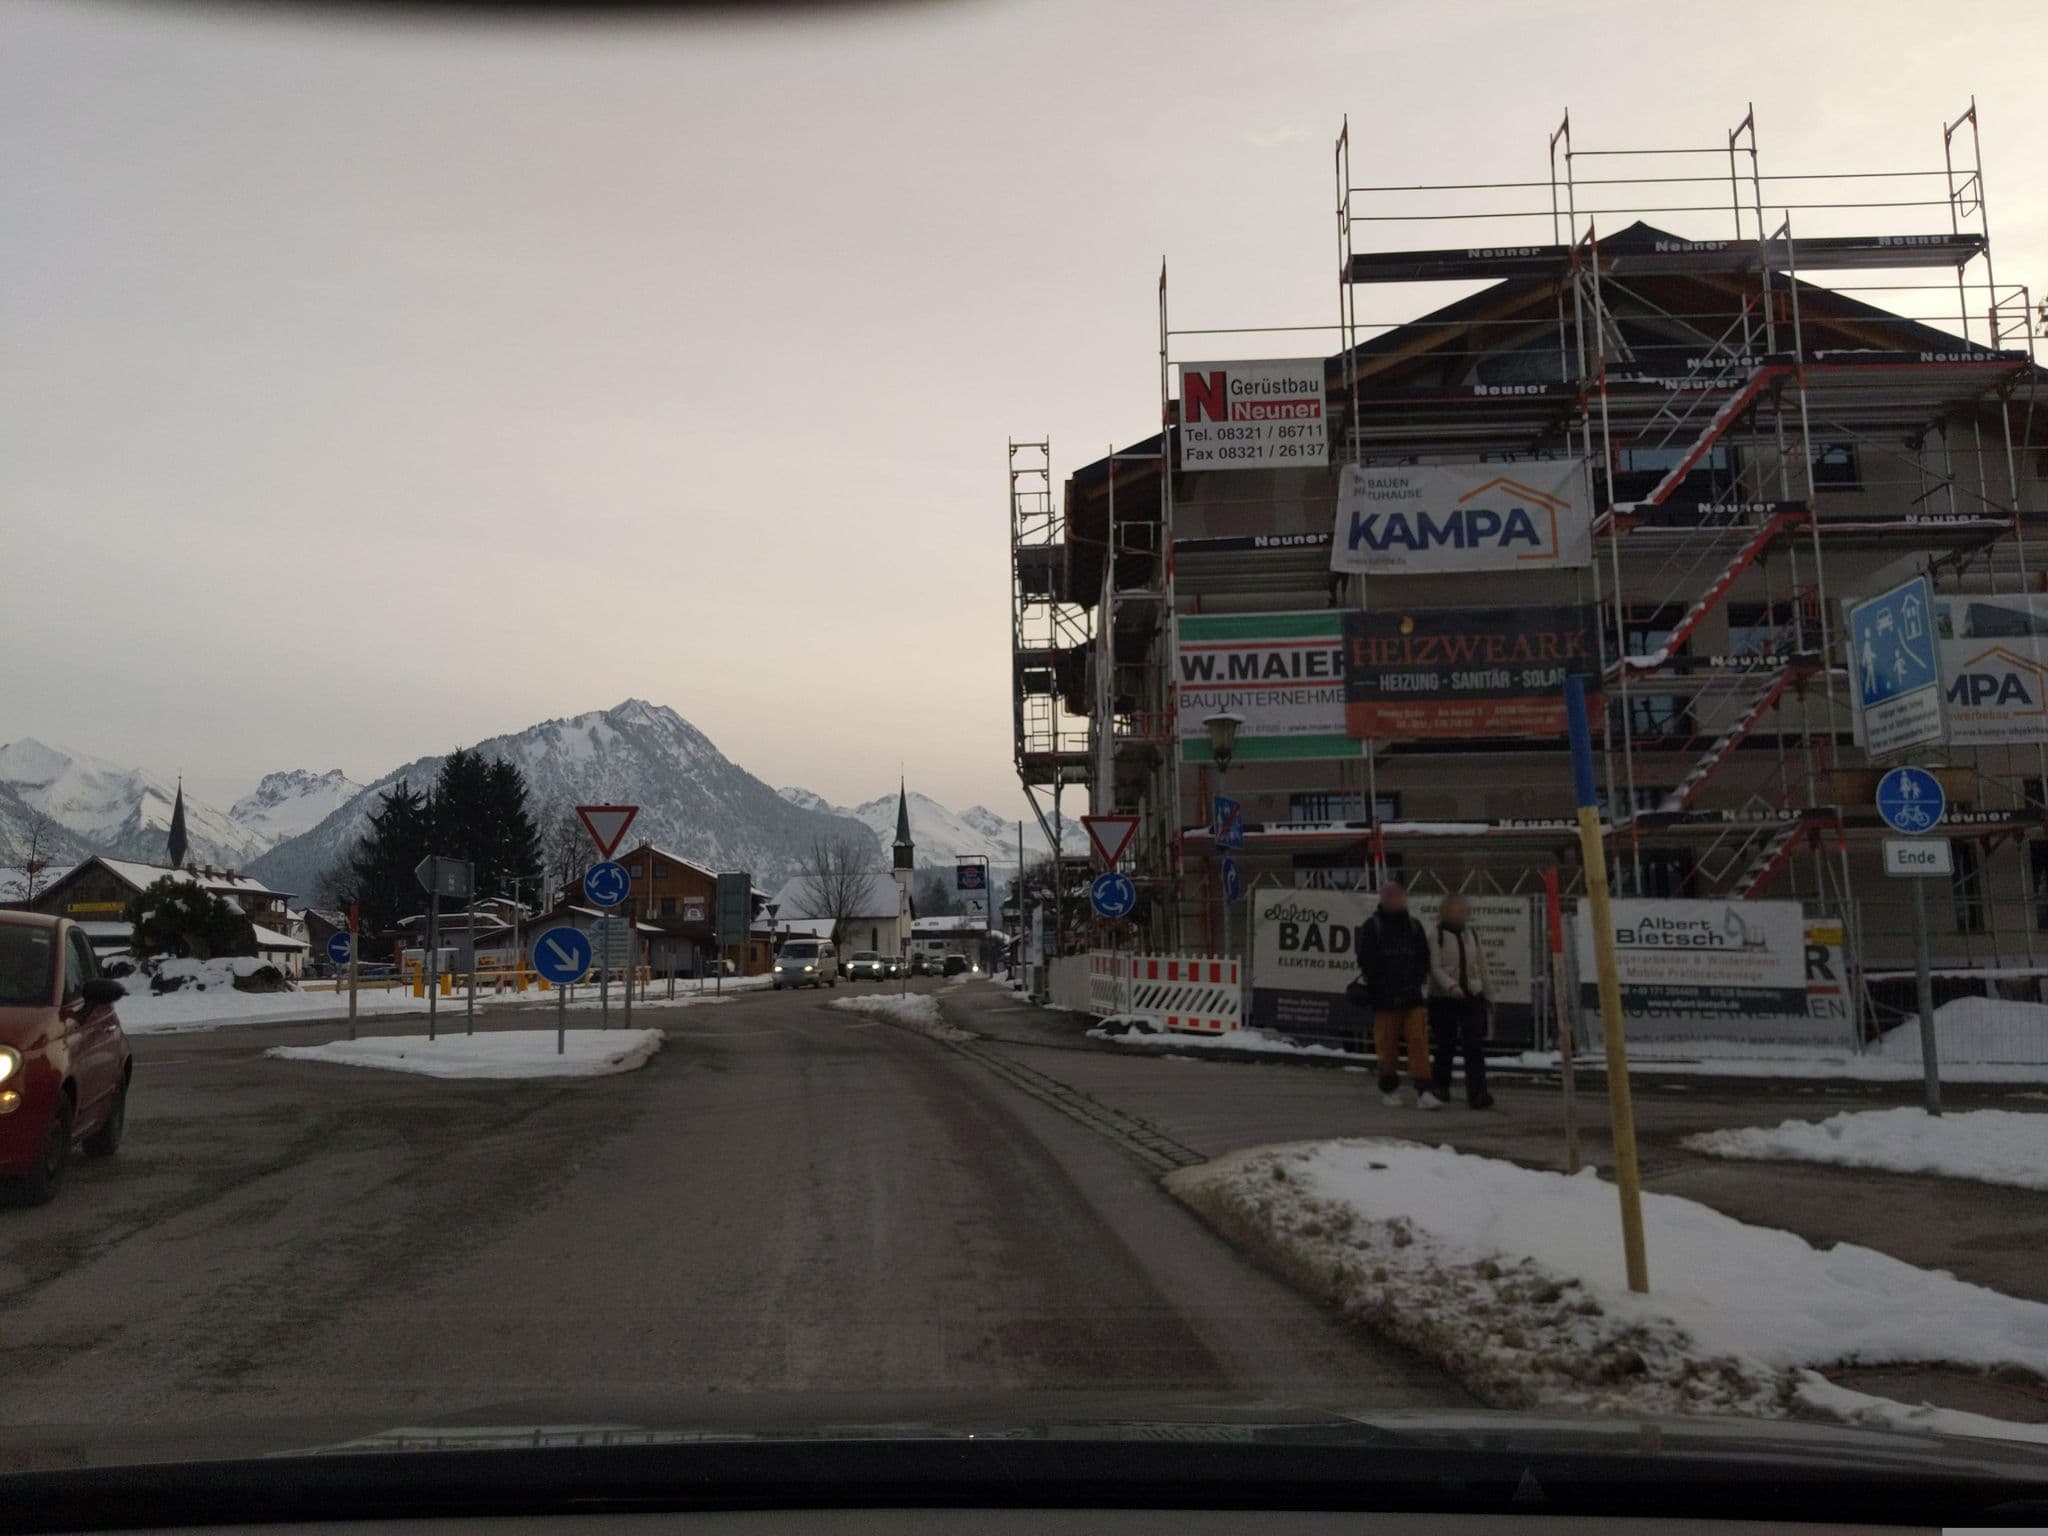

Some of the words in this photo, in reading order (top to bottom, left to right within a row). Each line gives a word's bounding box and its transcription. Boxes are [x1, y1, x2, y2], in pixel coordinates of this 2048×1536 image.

[1467, 247, 1542, 258] Neuner
[1920, 351, 1996, 362] Neuner
[1231, 378, 1319, 395] Gerüstbau
[1473, 384, 1549, 396] Neuner
[1184, 371, 1229, 423] N
[1234, 401, 1319, 420] Neuner
[1185, 430, 1213, 441] Tel.
[1217, 427, 1261, 441] 08321
[1278, 424, 1323, 438] 86711
[1186, 448, 1214, 461] Fax
[1219, 446, 1263, 459] 08321
[1279, 443, 1325, 457] 26137
[1349, 507, 1541, 550] KAMPA
[1254, 533, 1329, 547] Neuner
[1379, 673, 1439, 691] HEIZUNG
[1451, 668, 1511, 689] SANITÄR
[1946, 672, 2033, 706] MPA
[1180, 689, 1345, 709] BAUUNTERNEHME
[1898, 849, 1935, 864] Ende
[1640, 917, 1711, 930] Albert
[1279, 922, 1361, 953] BAD
[1616, 929, 1724, 946] Bietsch
[1278, 956, 1325, 968] ELEKTRO
